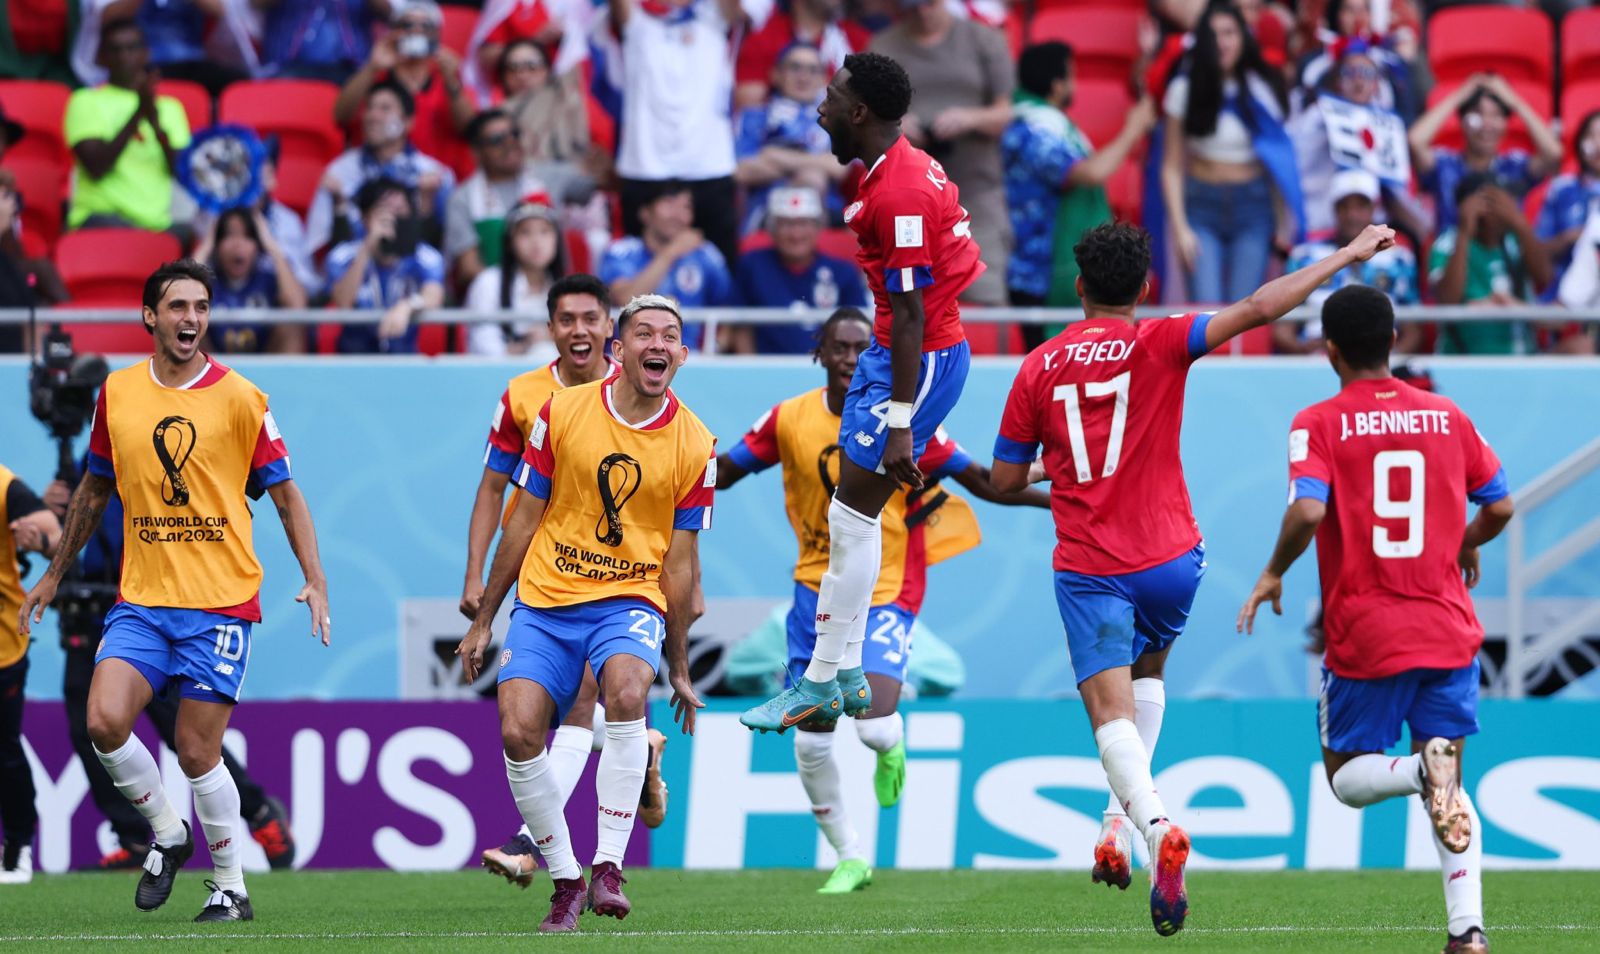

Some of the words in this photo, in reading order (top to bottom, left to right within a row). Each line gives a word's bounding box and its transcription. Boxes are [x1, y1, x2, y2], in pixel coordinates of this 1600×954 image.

[1042, 350, 1058, 371] Y.
[870, 399, 891, 435] 4
[1052, 371, 1131, 483] 17
[1340, 411, 1353, 441] J.
[1355, 410, 1450, 436] BENNETTE
[1373, 449, 1425, 558] 9
[133, 517, 153, 528] FIFA
[153, 516, 202, 527] WORLD
[205, 516, 229, 528] CUP
[554, 542, 578, 558] FIFA
[580, 549, 630, 570] WORLD
[633, 561, 658, 573] CUP
[214, 624, 243, 662] 10
[628, 609, 660, 644] 21
[684, 712, 1600, 870] Hisens
[598, 805, 633, 819] FCRF
